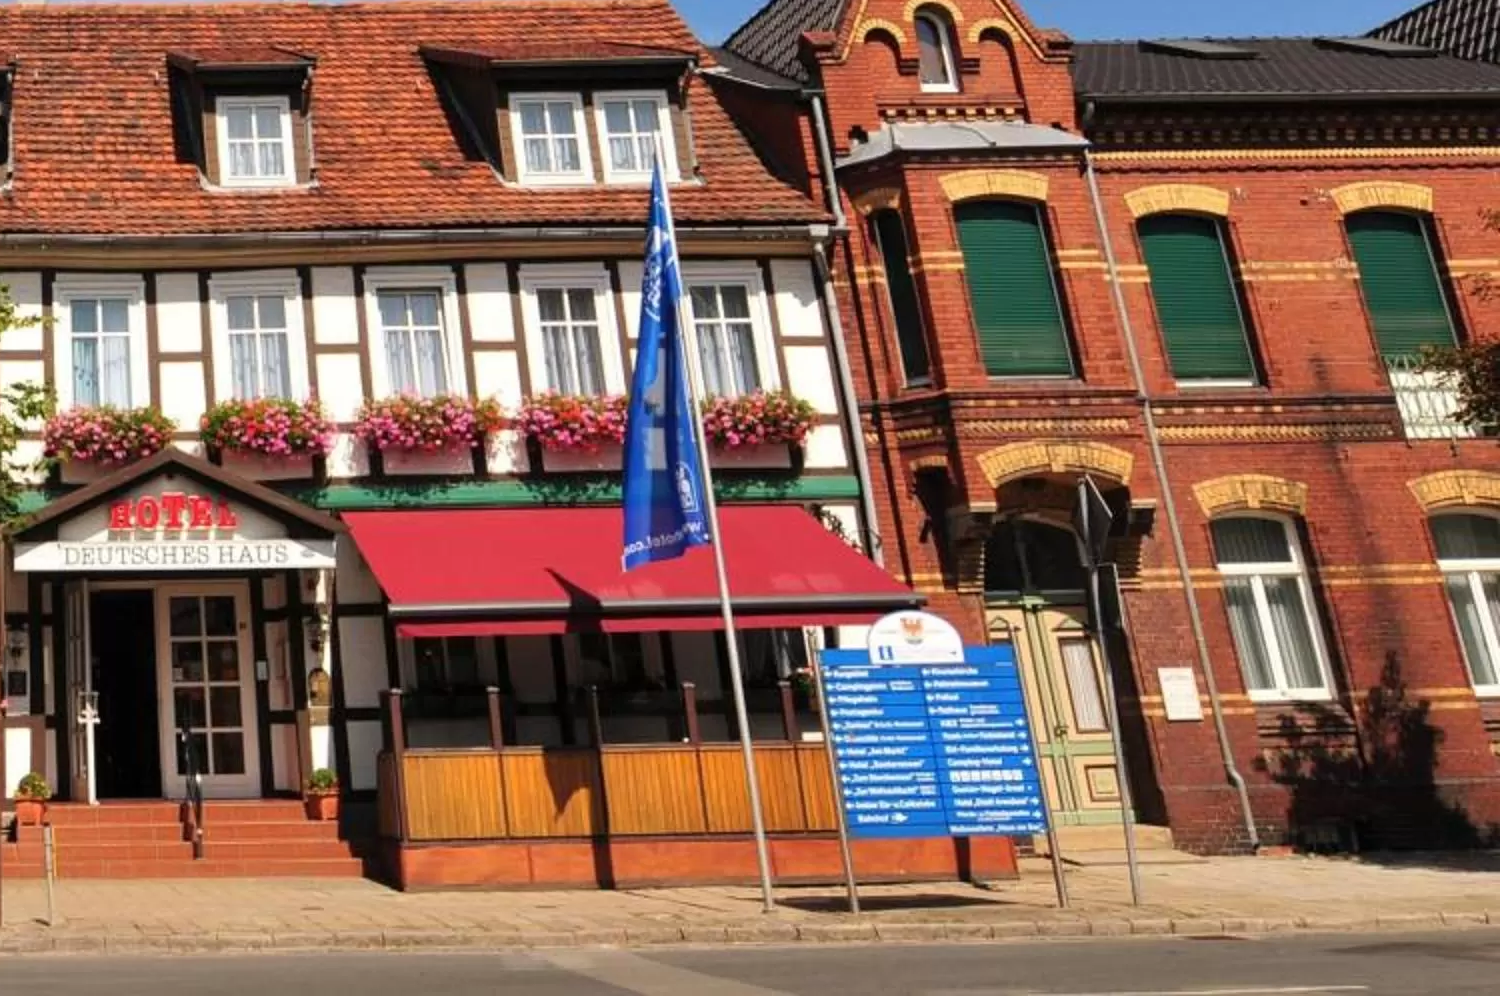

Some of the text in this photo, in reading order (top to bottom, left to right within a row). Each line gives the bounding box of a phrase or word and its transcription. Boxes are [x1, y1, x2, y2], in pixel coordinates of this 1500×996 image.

[109, 491, 238, 531] HOTEL
[64, 544, 289, 566] DEUTSCHES HAUS
